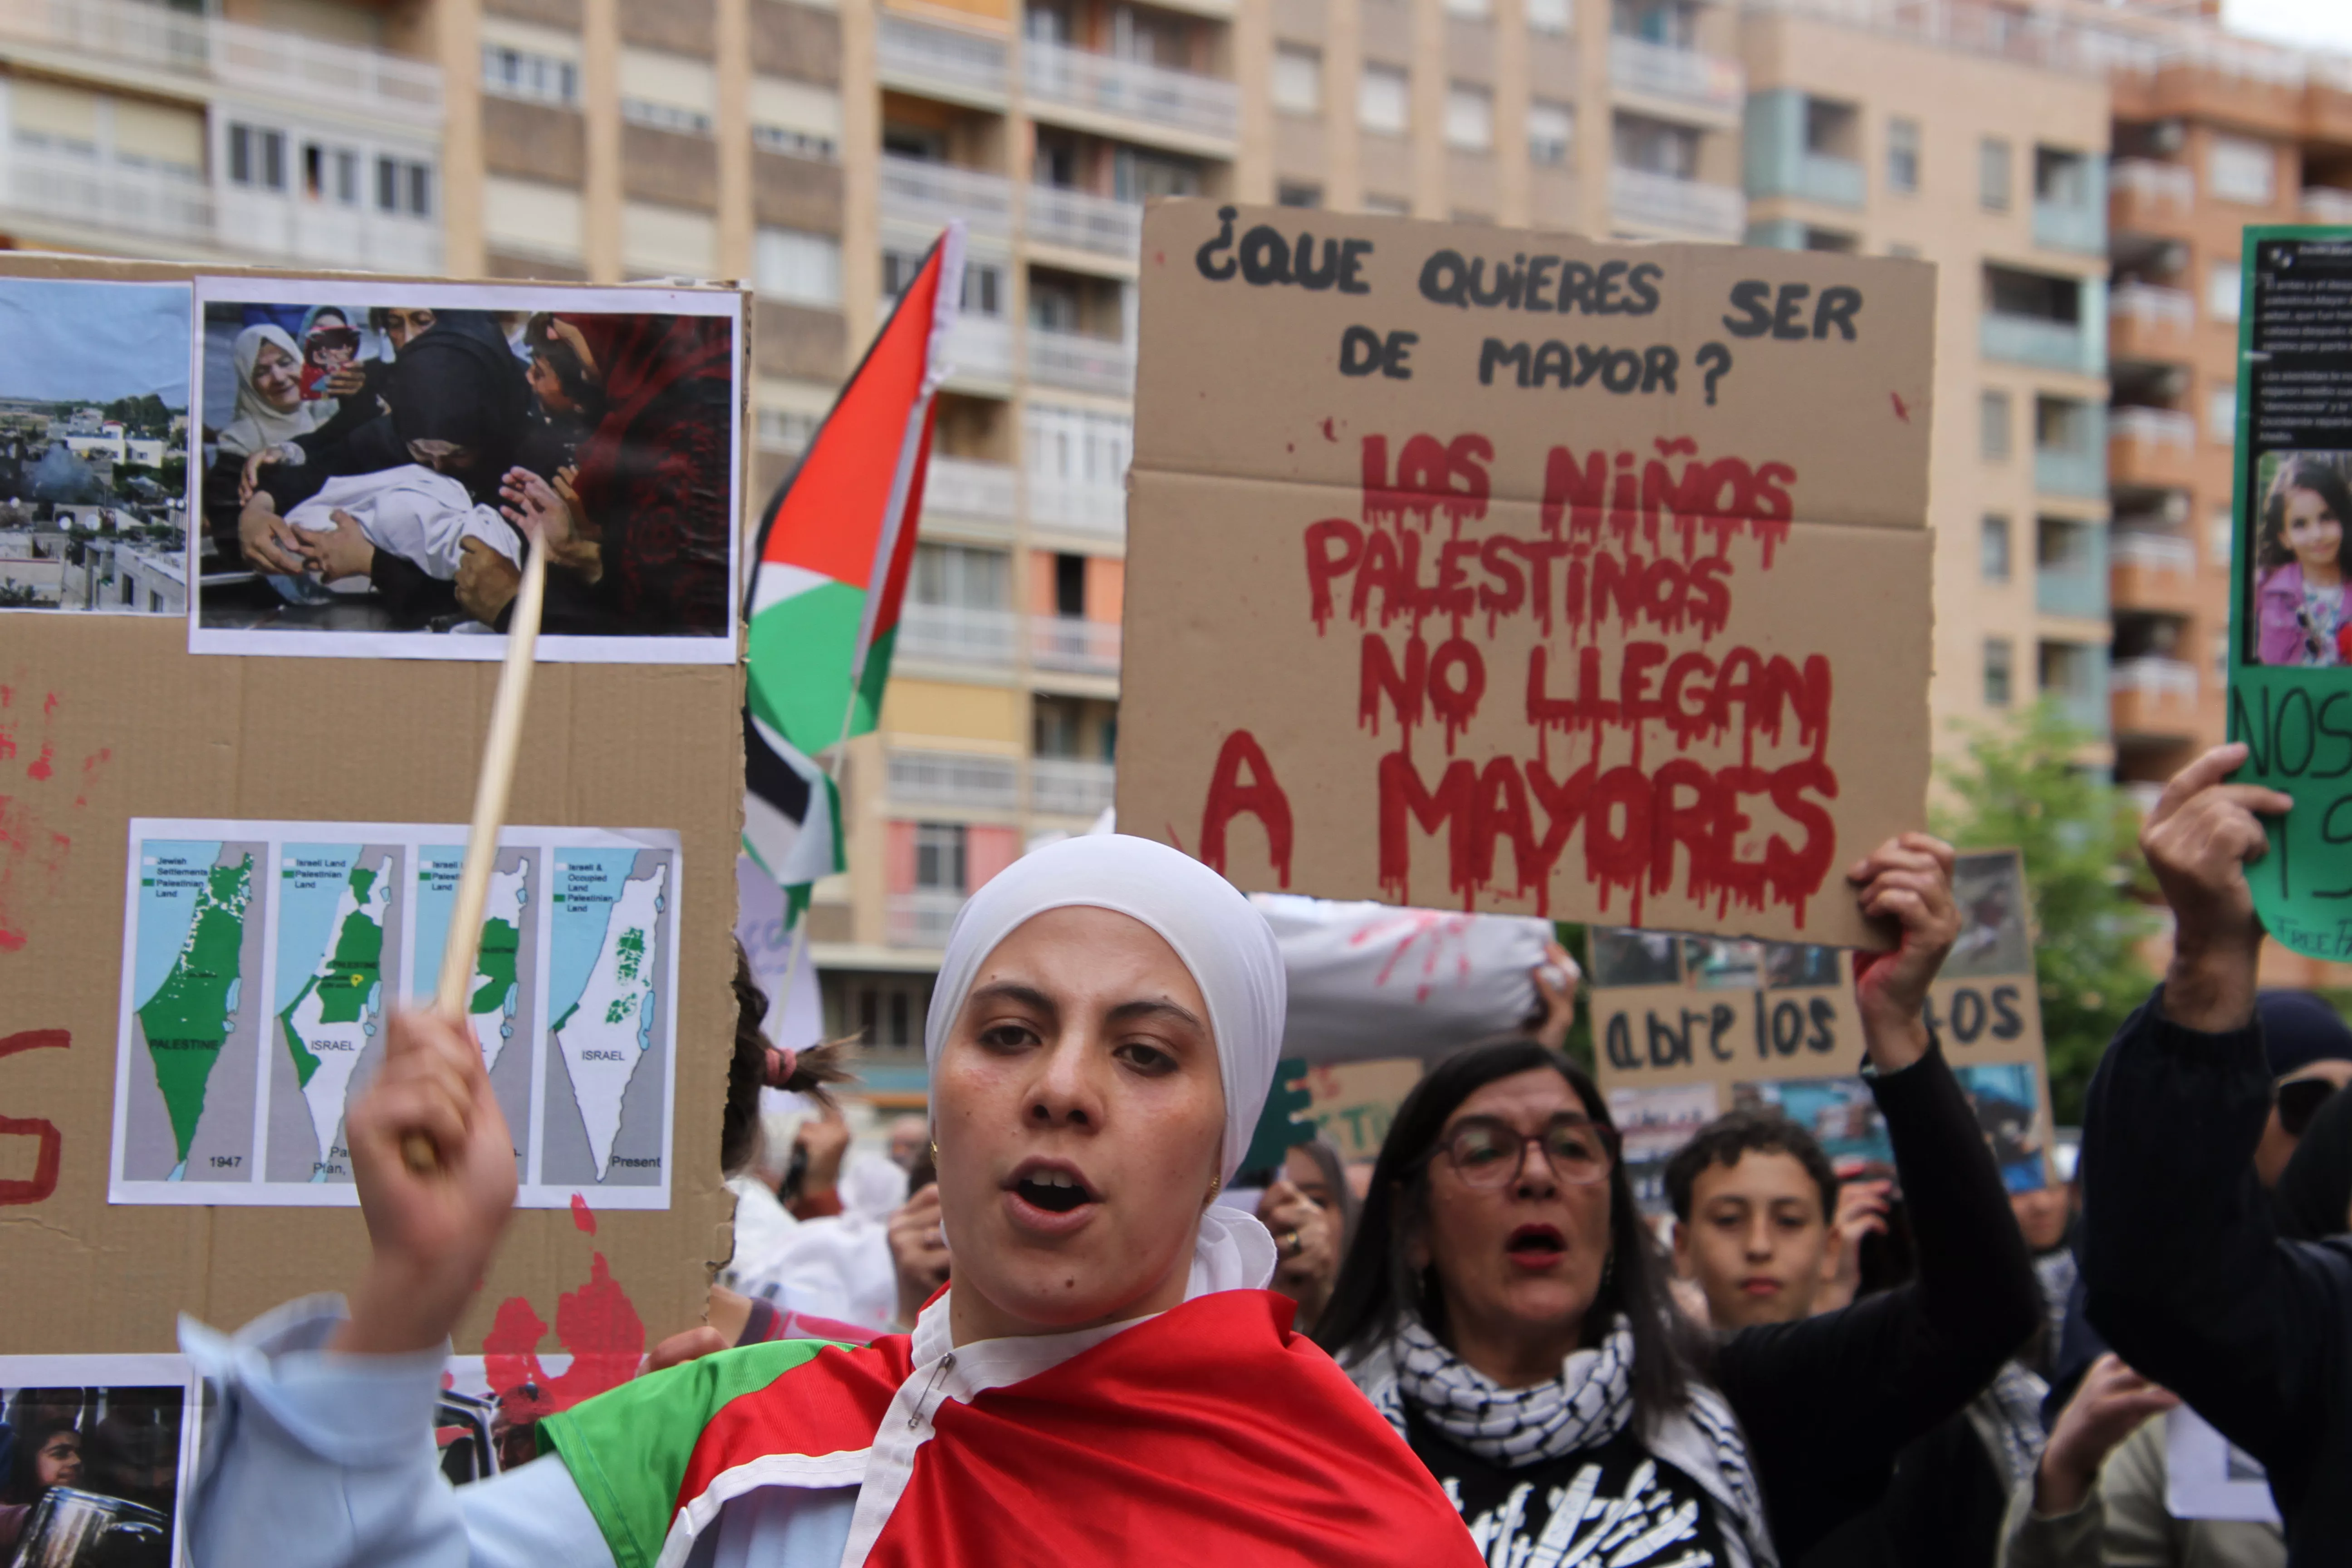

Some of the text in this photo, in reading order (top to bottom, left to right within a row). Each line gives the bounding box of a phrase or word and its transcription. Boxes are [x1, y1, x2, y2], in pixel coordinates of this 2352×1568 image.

[1196, 206, 1374, 294] ¿QUE
[1721, 279, 1863, 342] SER
[1338, 325, 1420, 380] DE
[1362, 434, 1496, 535] LOS
[1361, 633, 1833, 749] NO LLEGAN
[1199, 729, 1840, 916] A MAYORES
[157, 867, 208, 876] Settlements
[295, 870, 342, 878] Palestinian
[156, 879, 204, 887] Palestinian
[568, 874, 608, 883] Occupied
[149, 1039, 219, 1050] PALESTINE
[311, 1040, 355, 1051] ISRAEL
[582, 1050, 626, 1061] ISRAEL
[209, 1156, 242, 1168] 1947
[612, 1156, 661, 1168] Present
